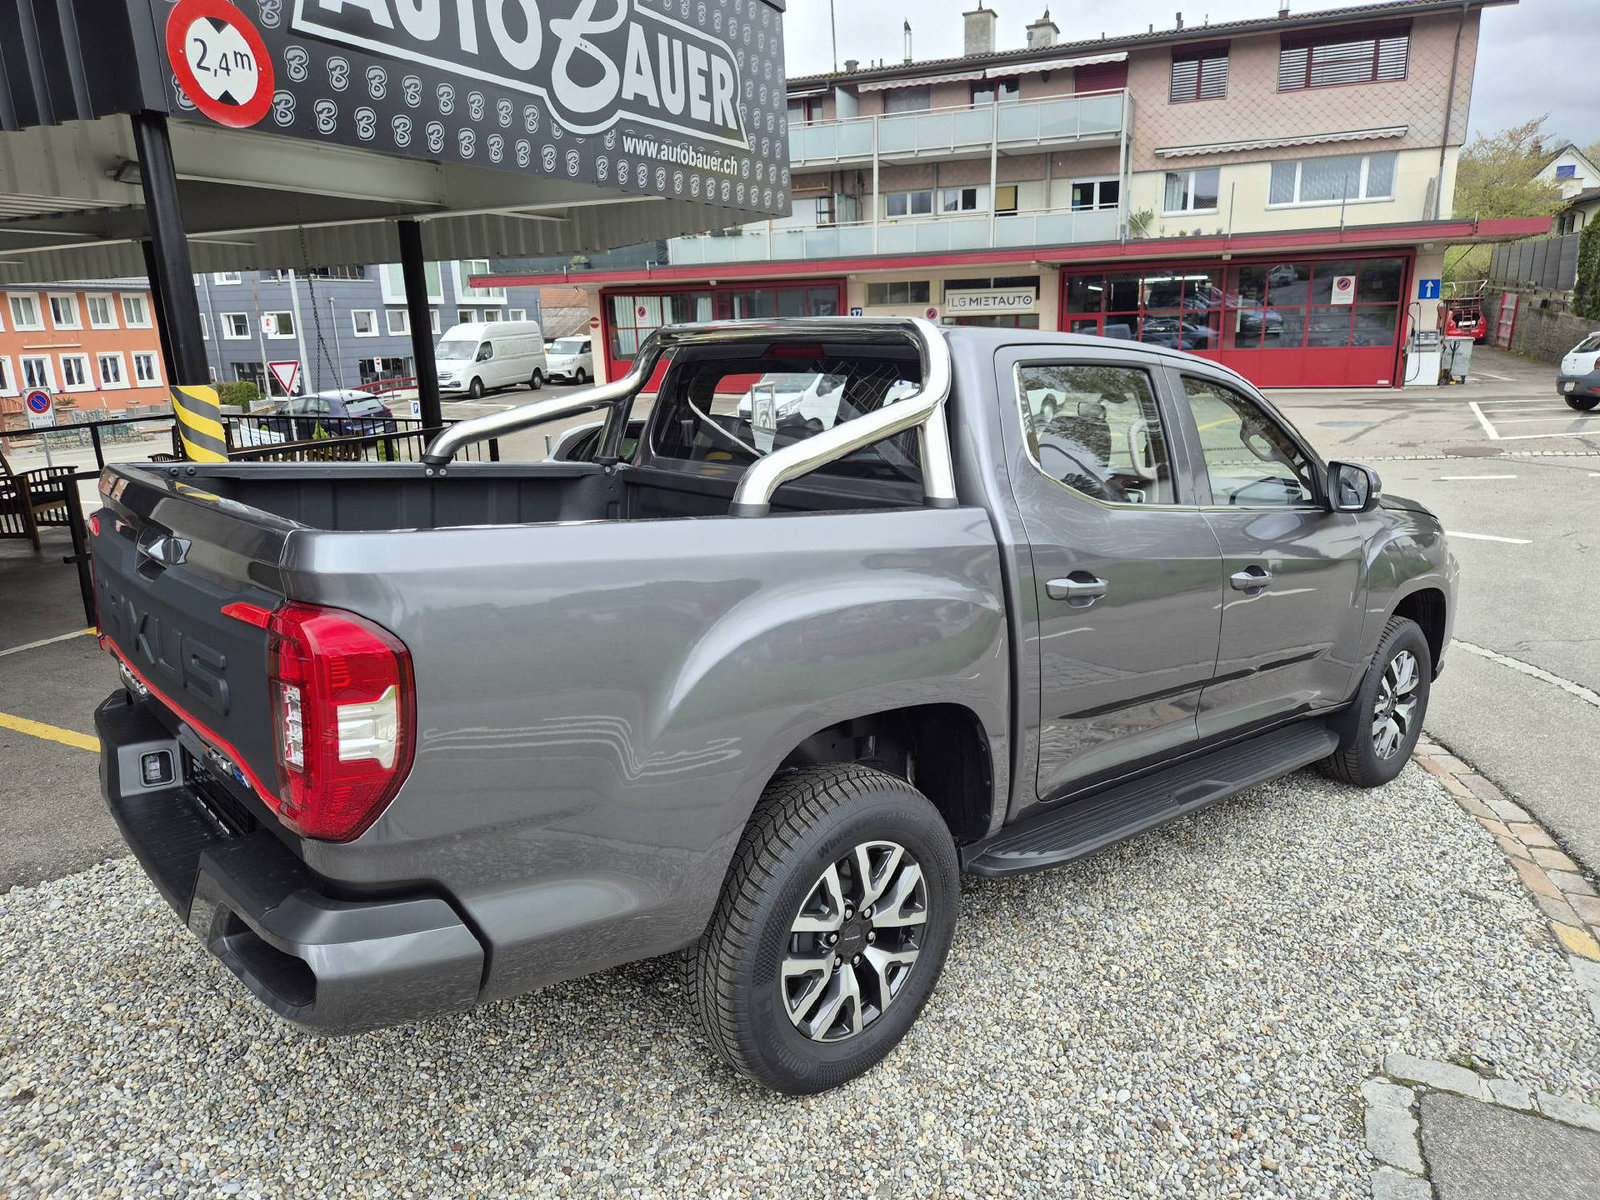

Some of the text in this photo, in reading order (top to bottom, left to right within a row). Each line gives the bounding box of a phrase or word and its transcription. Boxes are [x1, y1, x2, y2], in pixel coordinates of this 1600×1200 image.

[319, 0, 542, 71] TO
[622, 135, 738, 176] www.autobauer.ch
[851, 308, 862, 317] 17
[968, 294, 1033, 307] MIETAUTO
